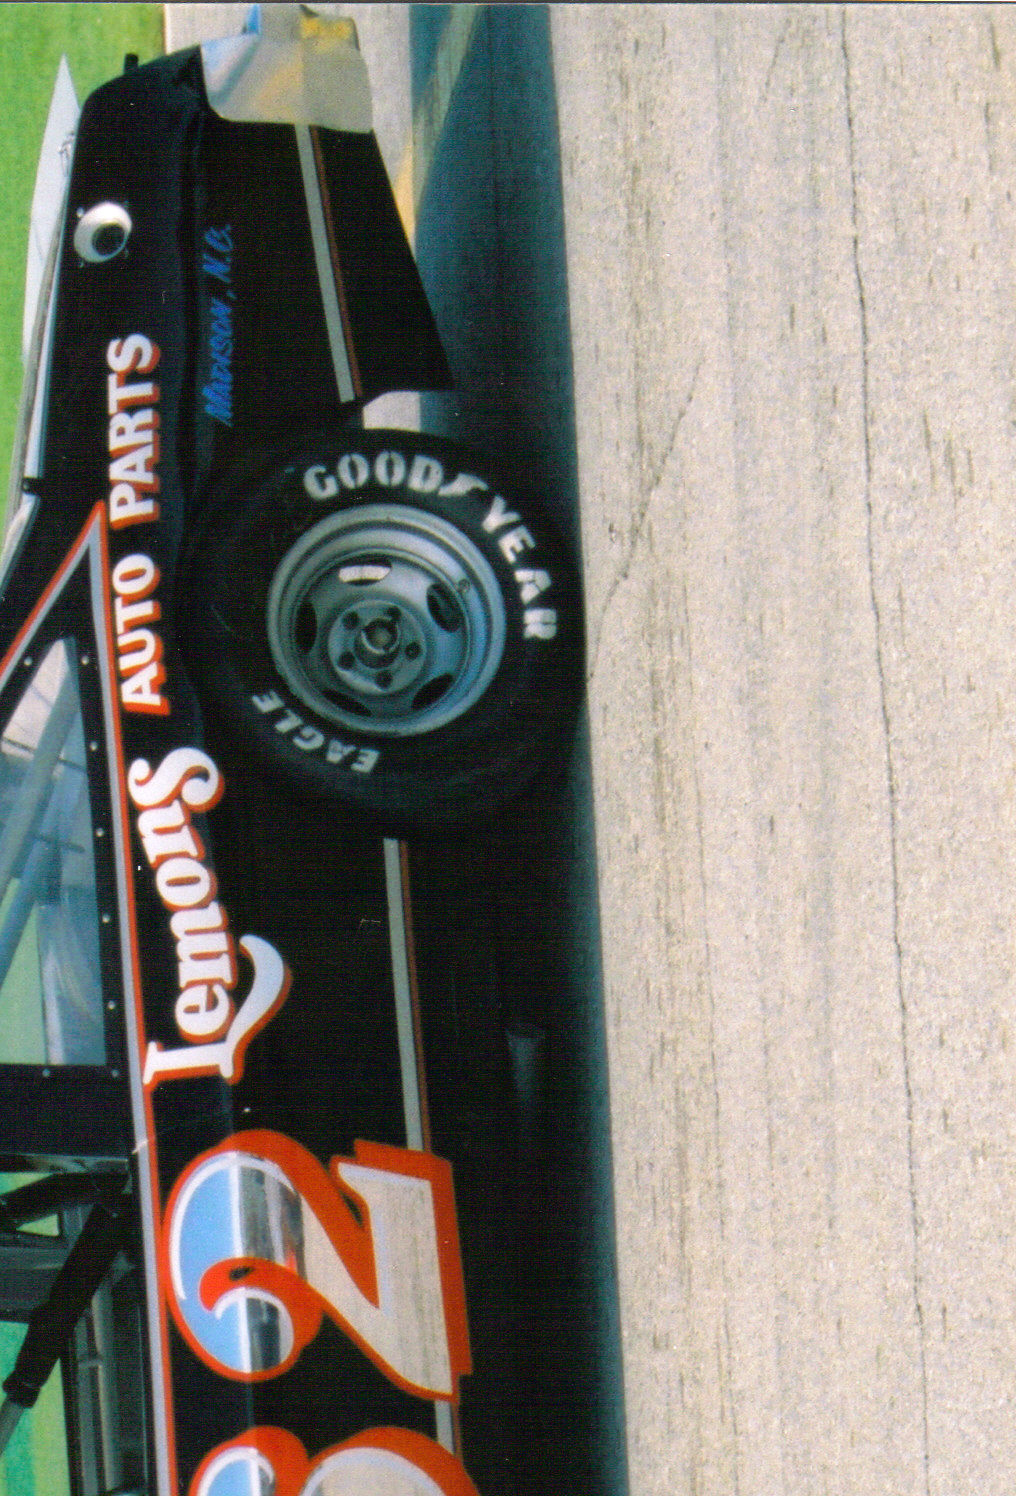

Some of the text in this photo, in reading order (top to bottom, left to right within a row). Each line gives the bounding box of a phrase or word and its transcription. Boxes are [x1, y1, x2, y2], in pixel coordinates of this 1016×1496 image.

[107, 332, 171, 716] AUTO PARTS
[302, 449, 558, 641] GOODYEAR
[251, 690, 381, 773] EAGLE
[127, 747, 292, 1086] Lemons
